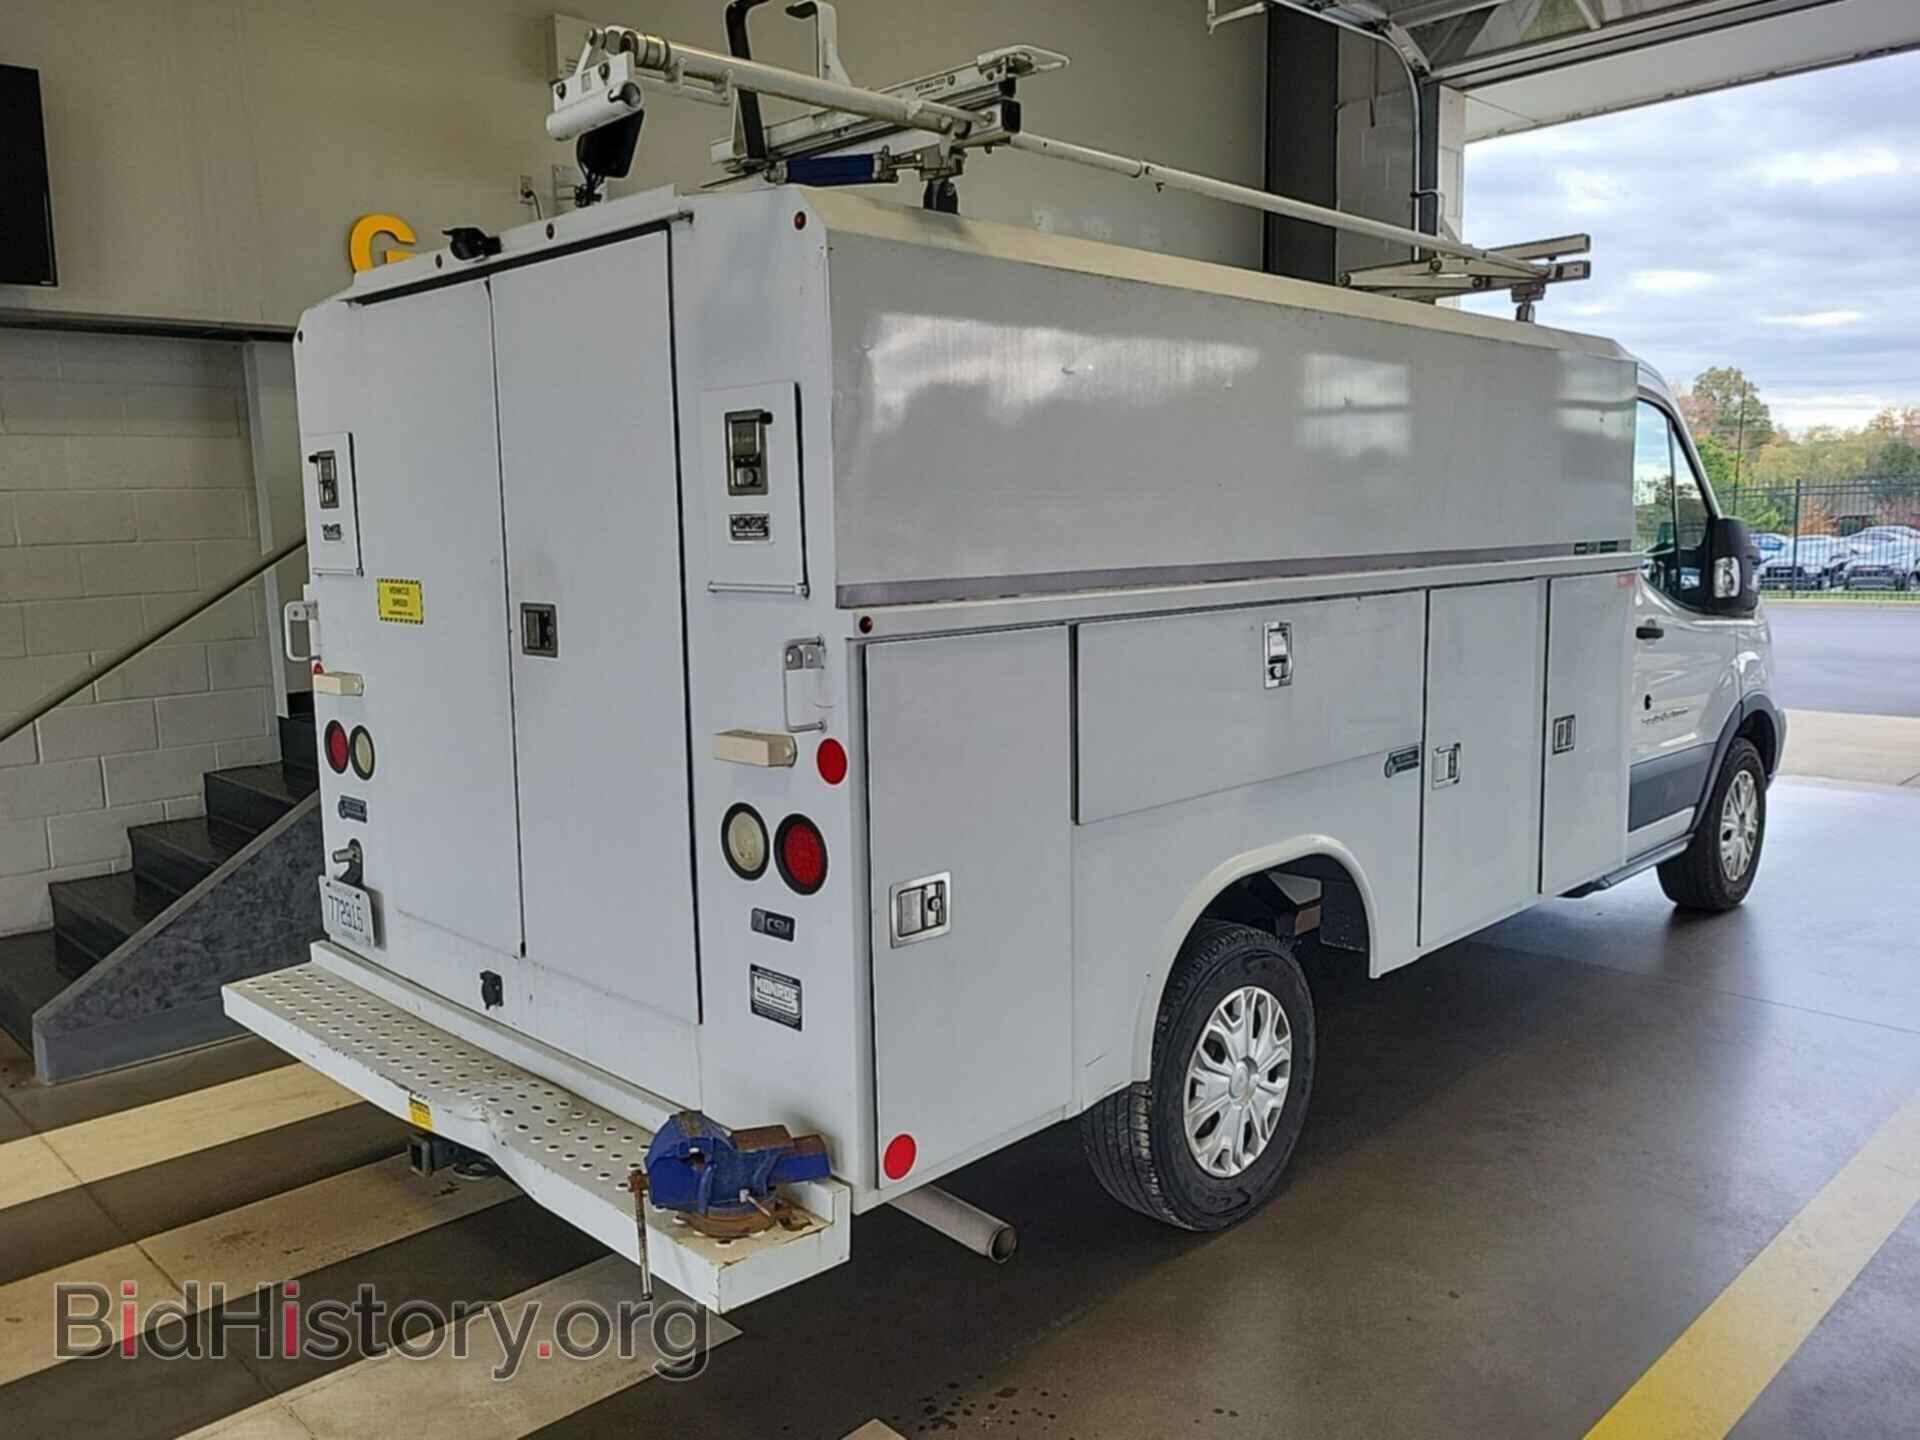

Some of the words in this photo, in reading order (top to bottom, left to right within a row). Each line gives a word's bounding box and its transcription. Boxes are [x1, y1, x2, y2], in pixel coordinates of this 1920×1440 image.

[348, 212, 417, 272] G
[734, 516, 769, 531] MONROE
[754, 975, 798, 1003] MONROE
